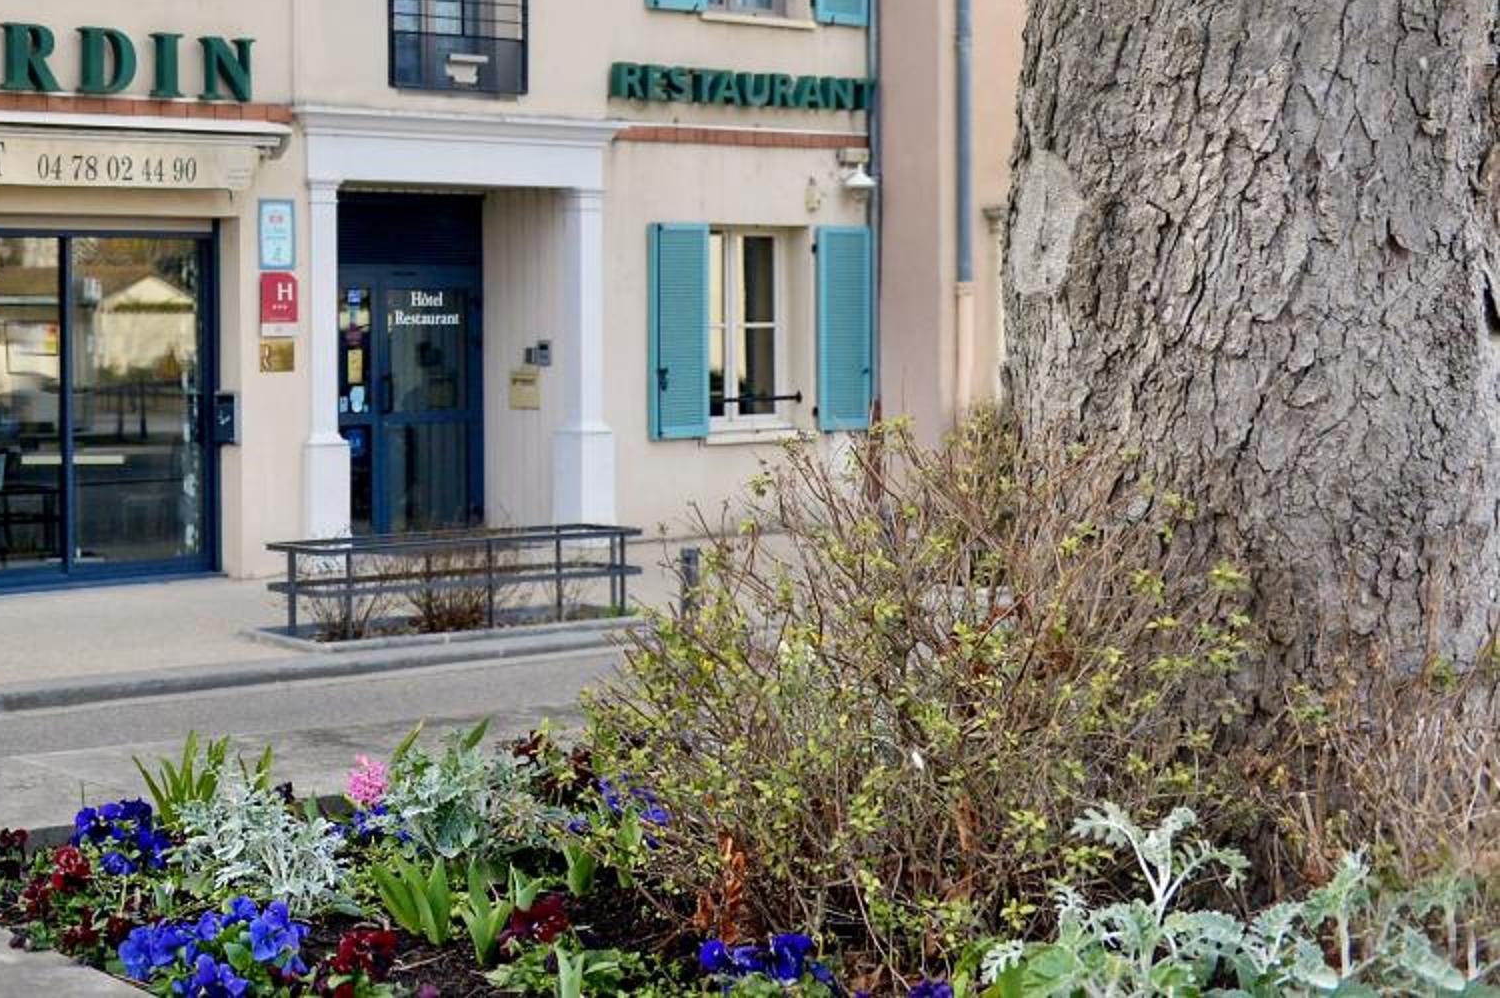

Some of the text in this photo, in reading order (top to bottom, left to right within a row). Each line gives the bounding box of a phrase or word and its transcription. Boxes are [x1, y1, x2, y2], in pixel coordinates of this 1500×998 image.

[37, 153, 62, 180] 04
[71, 155, 98, 181] 78
[107, 156, 133, 181] 02
[141, 157, 164, 183] 44
[173, 157, 197, 183] 90
[277, 282, 293, 301] H
[411, 290, 443, 307] Hôtel
[395, 310, 460, 325] Restaurant
